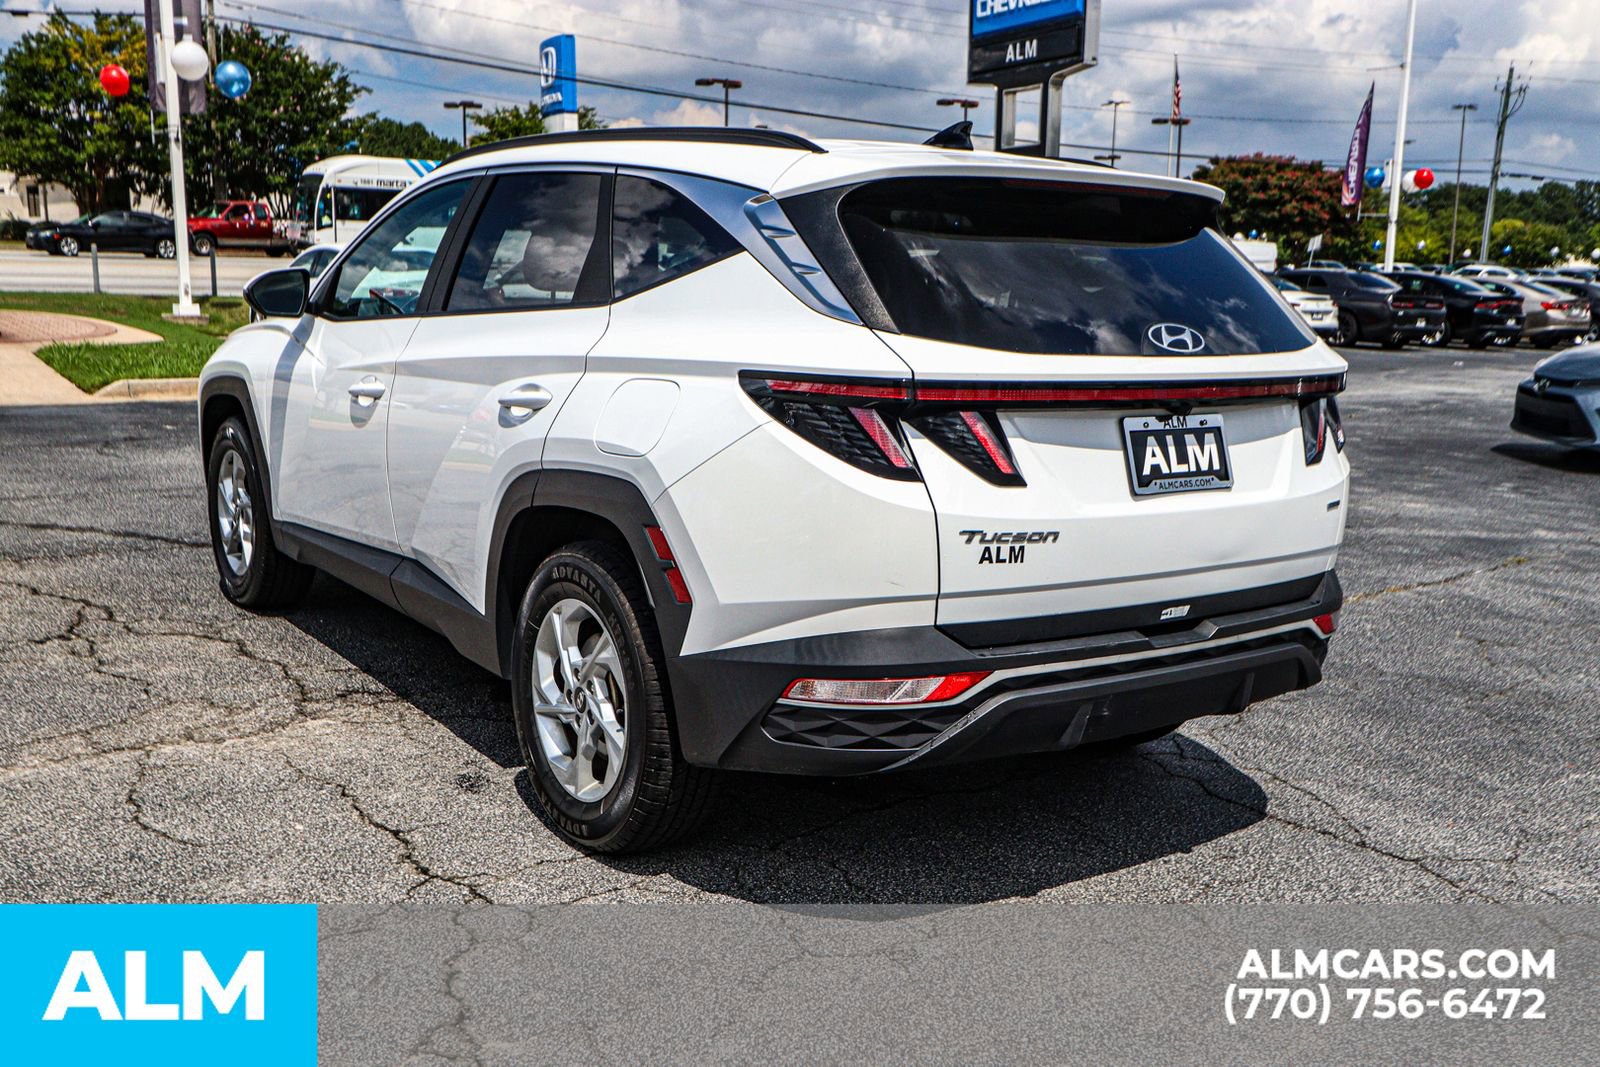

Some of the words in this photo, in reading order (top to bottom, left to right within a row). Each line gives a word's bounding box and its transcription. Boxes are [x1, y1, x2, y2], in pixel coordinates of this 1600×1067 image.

[1005, 39, 1037, 63] ALM
[376, 178, 407, 188] marta
[1163, 415, 1188, 429] ALM
[1142, 432, 1220, 476] ALM
[1158, 478, 1213, 490] ALMCARS.COM
[978, 545, 1025, 564] ALM
[553, 566, 601, 603] ADVANTA
